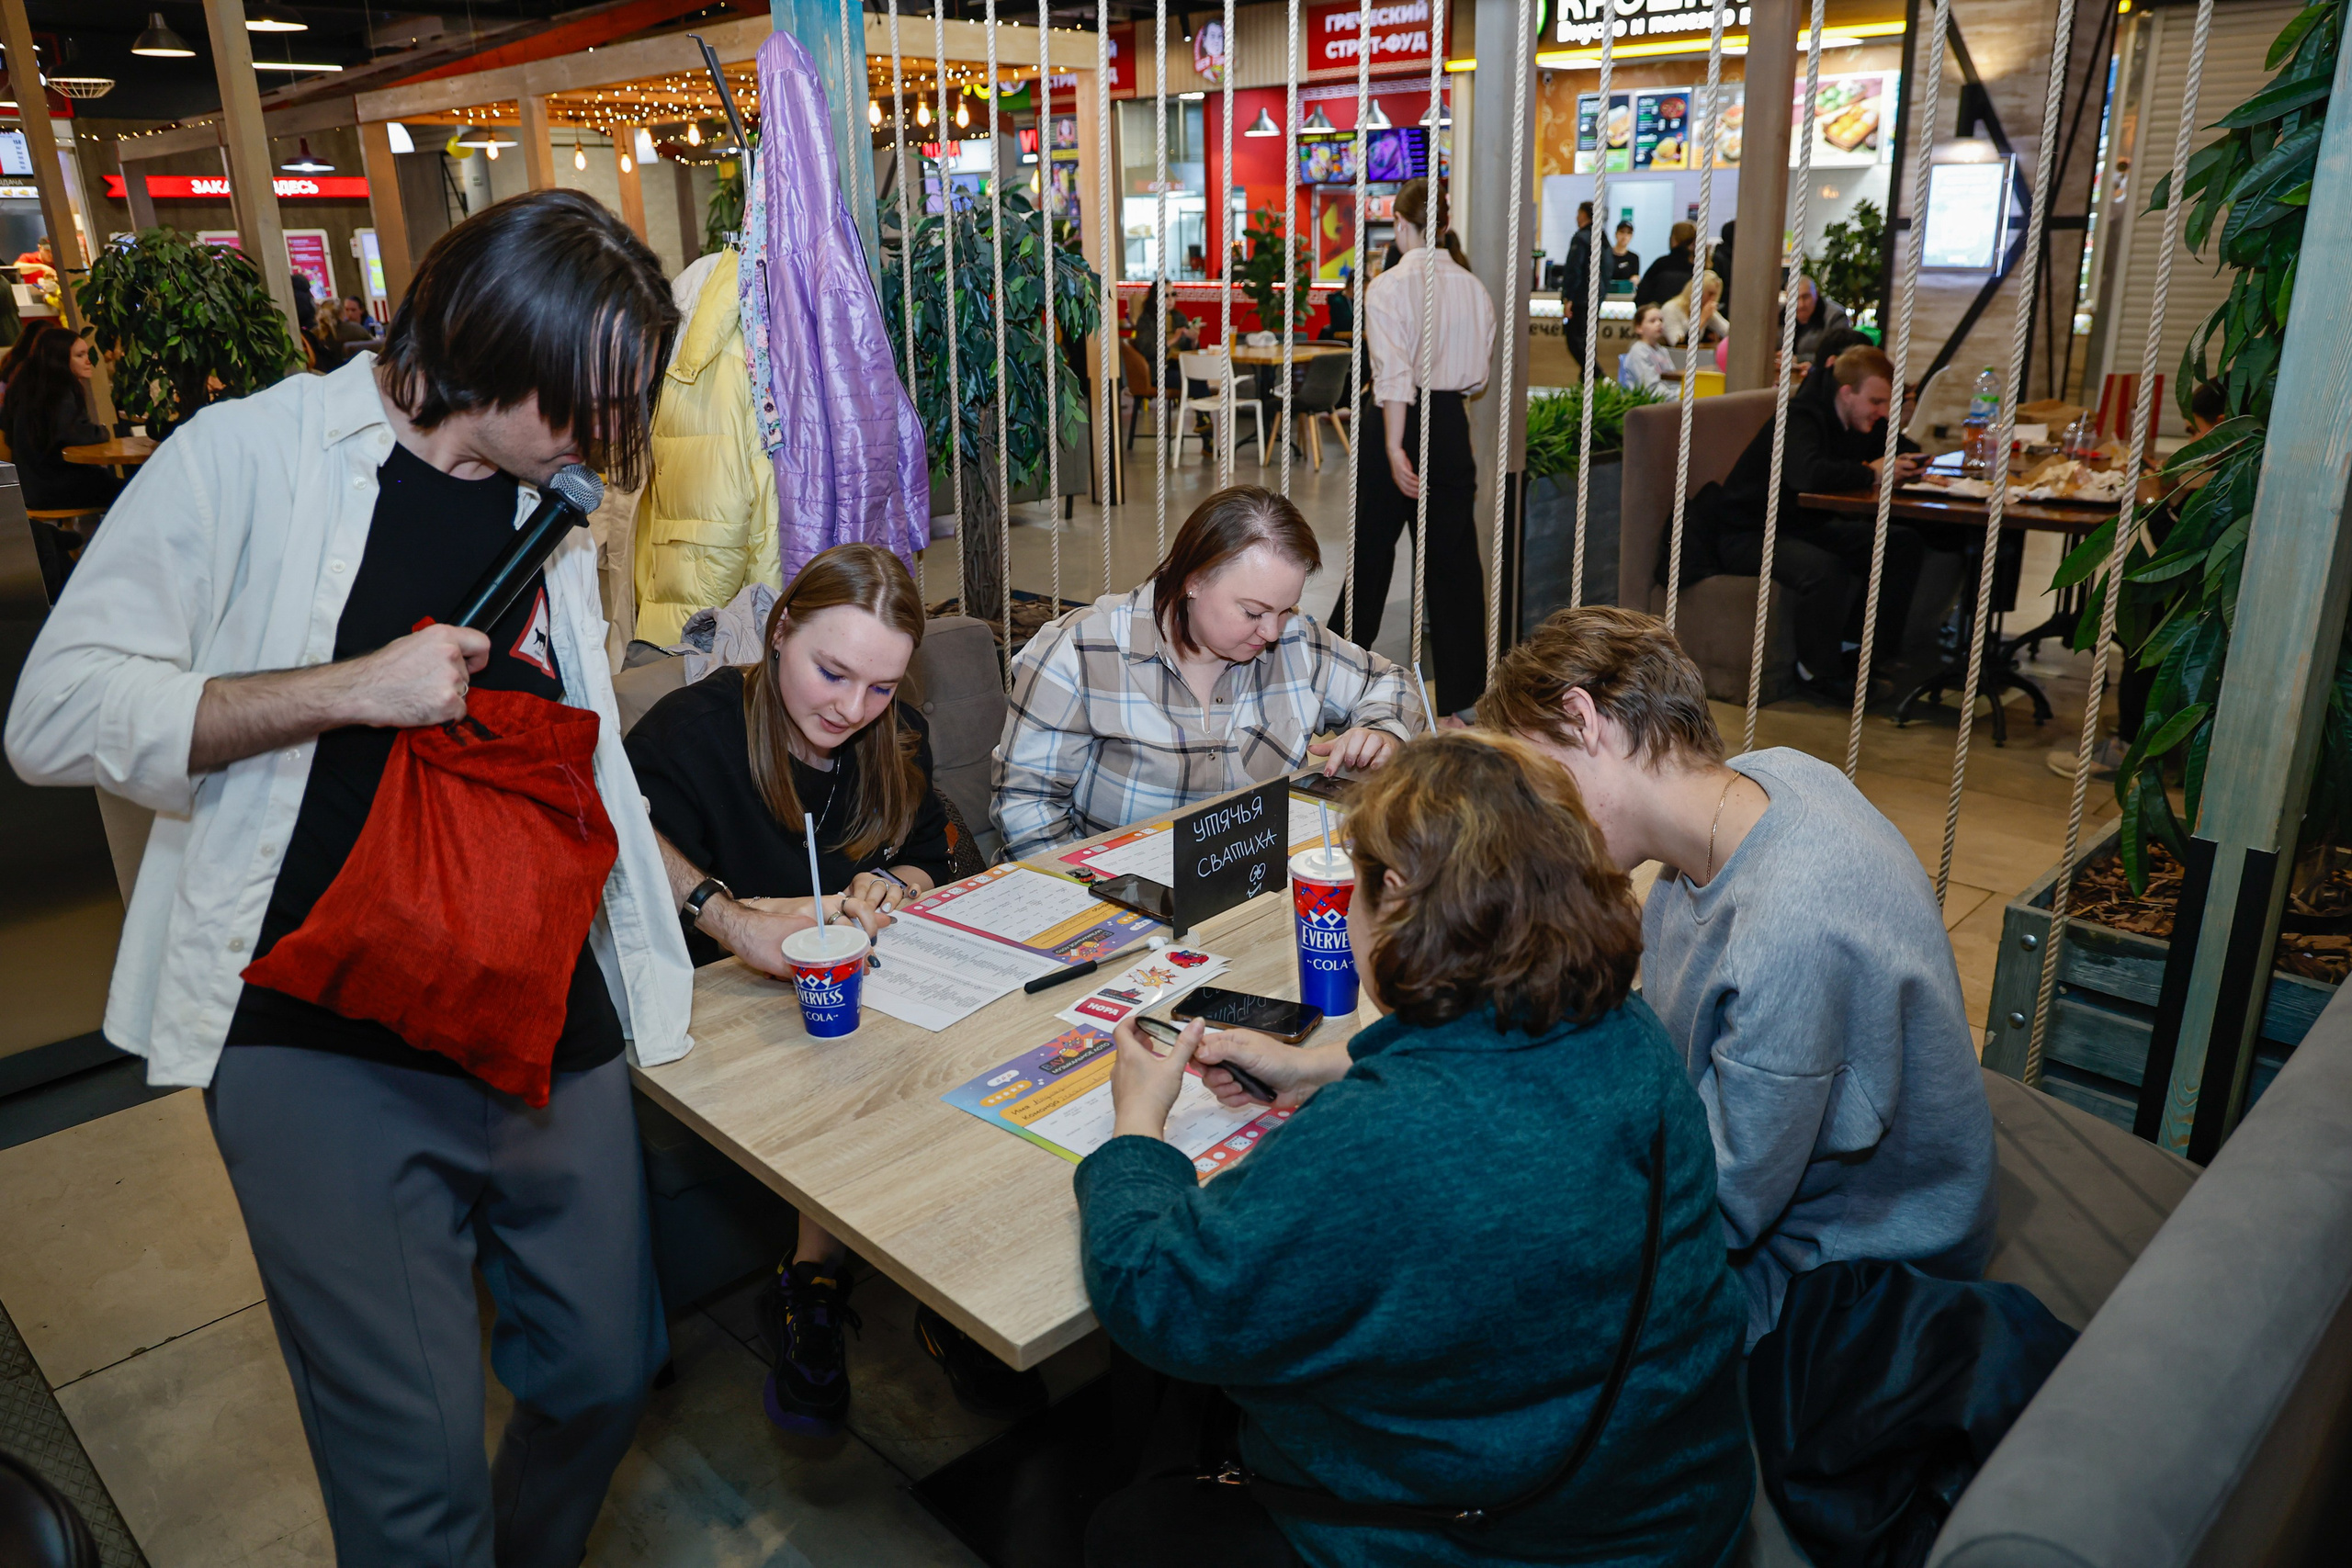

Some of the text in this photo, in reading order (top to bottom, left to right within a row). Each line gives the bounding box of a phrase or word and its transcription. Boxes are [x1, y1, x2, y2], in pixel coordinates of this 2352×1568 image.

[1557, 19, 1627, 45] Вкусо
[1648, 8, 1736, 34] полезо
[1325, 30, 1428, 59] СТРТ-ФУД
[191, 179, 231, 194] ЗАКА
[1197, 829, 1277, 878] СВАТИХА
[1302, 924, 1351, 950] EVERVE
[1313, 958, 1349, 971] COLA
[806, 1010, 833, 1022] COLA
